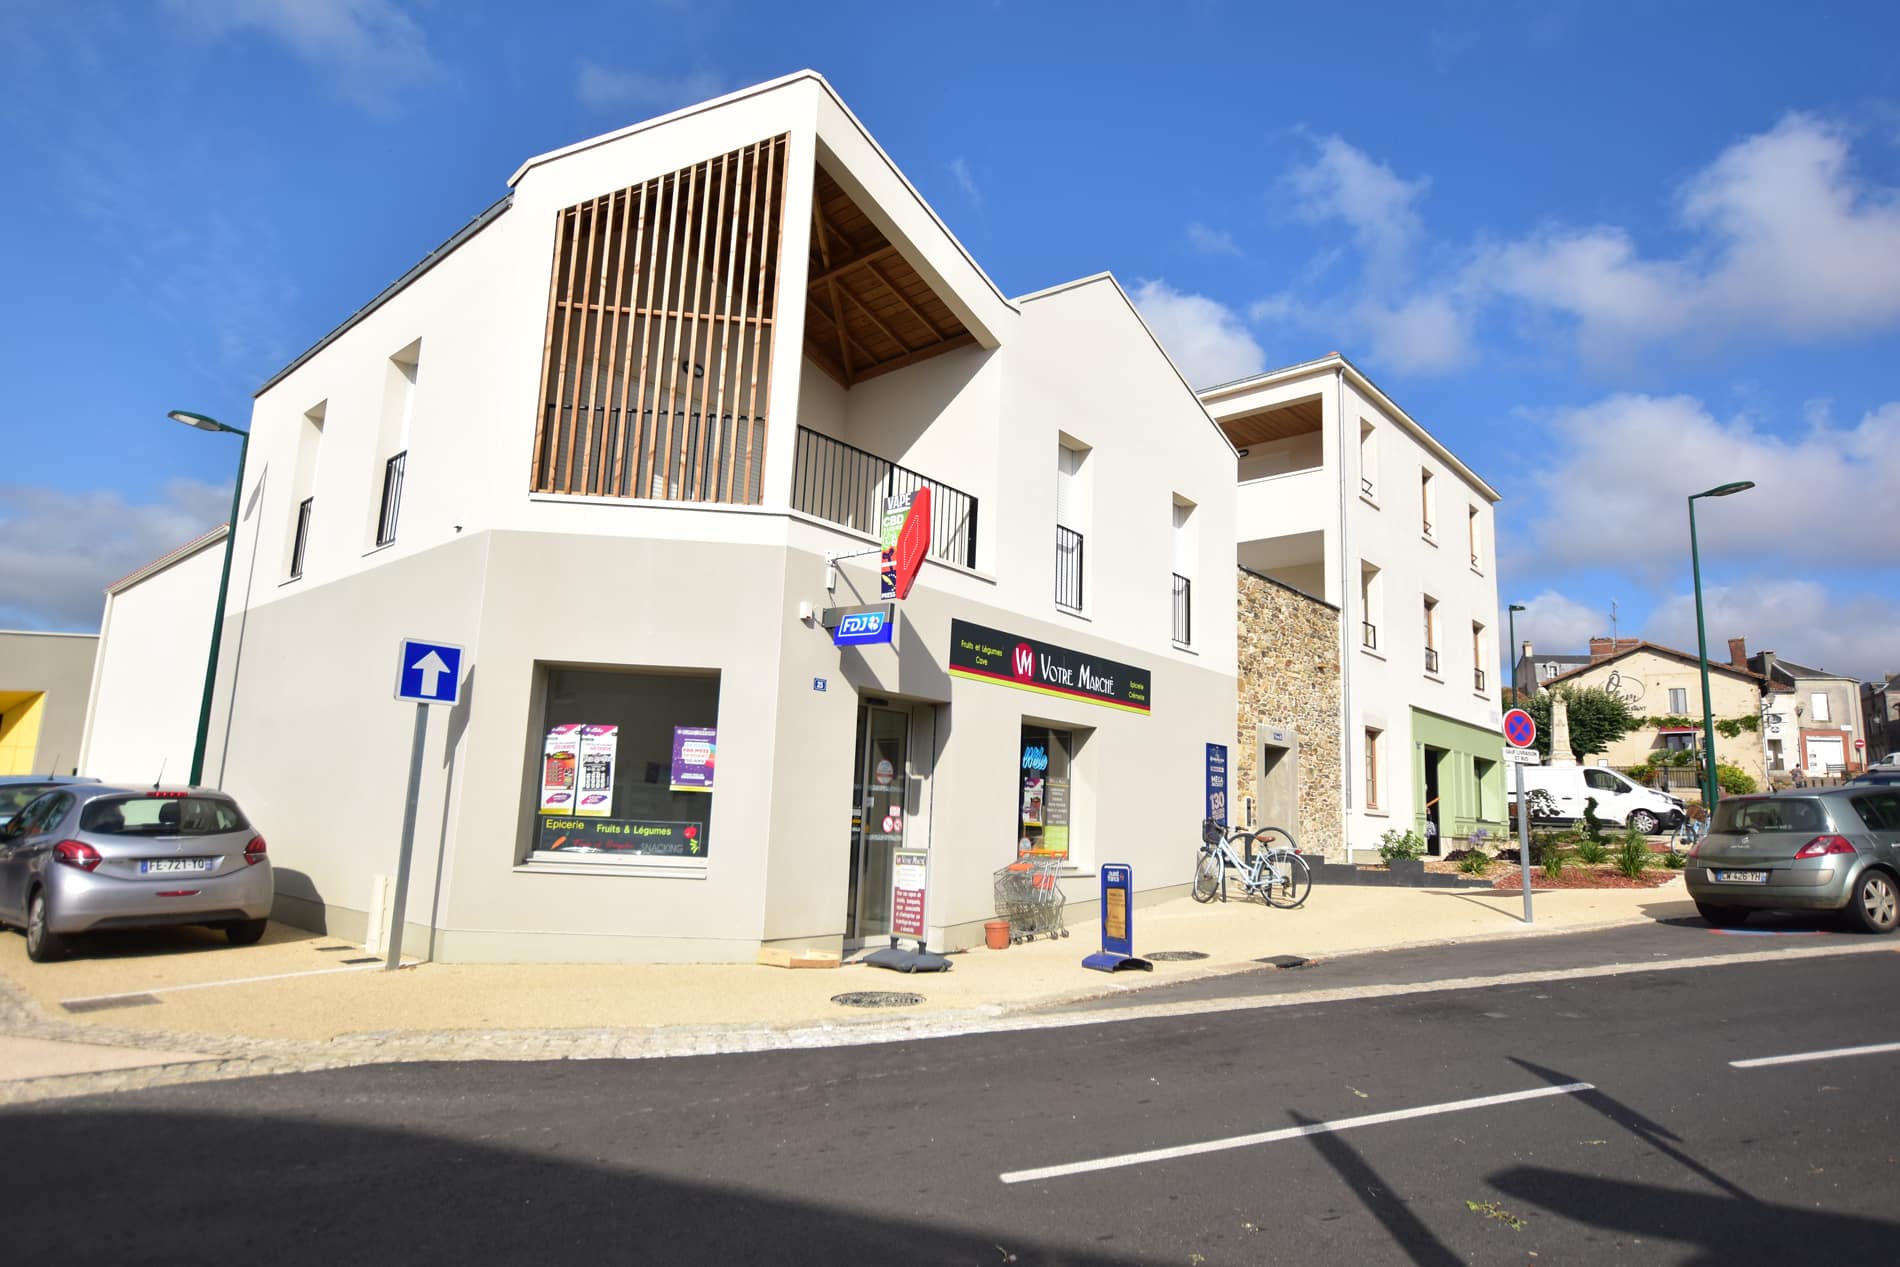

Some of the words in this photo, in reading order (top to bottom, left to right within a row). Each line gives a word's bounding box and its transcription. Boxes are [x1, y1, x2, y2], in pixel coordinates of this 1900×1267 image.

[887, 493, 911, 510] VAPE
[883, 513, 904, 527] CBD
[843, 617, 868, 632] FDJ
[961, 639, 973, 650] Fruits
[975, 655, 988, 666] Cave
[1209, 791, 1225, 809] 130
[545, 819, 584, 830] Epicerie
[596, 824, 620, 834] Fruits
[624, 826, 630, 834] &
[634, 825, 672, 837] Légumes
